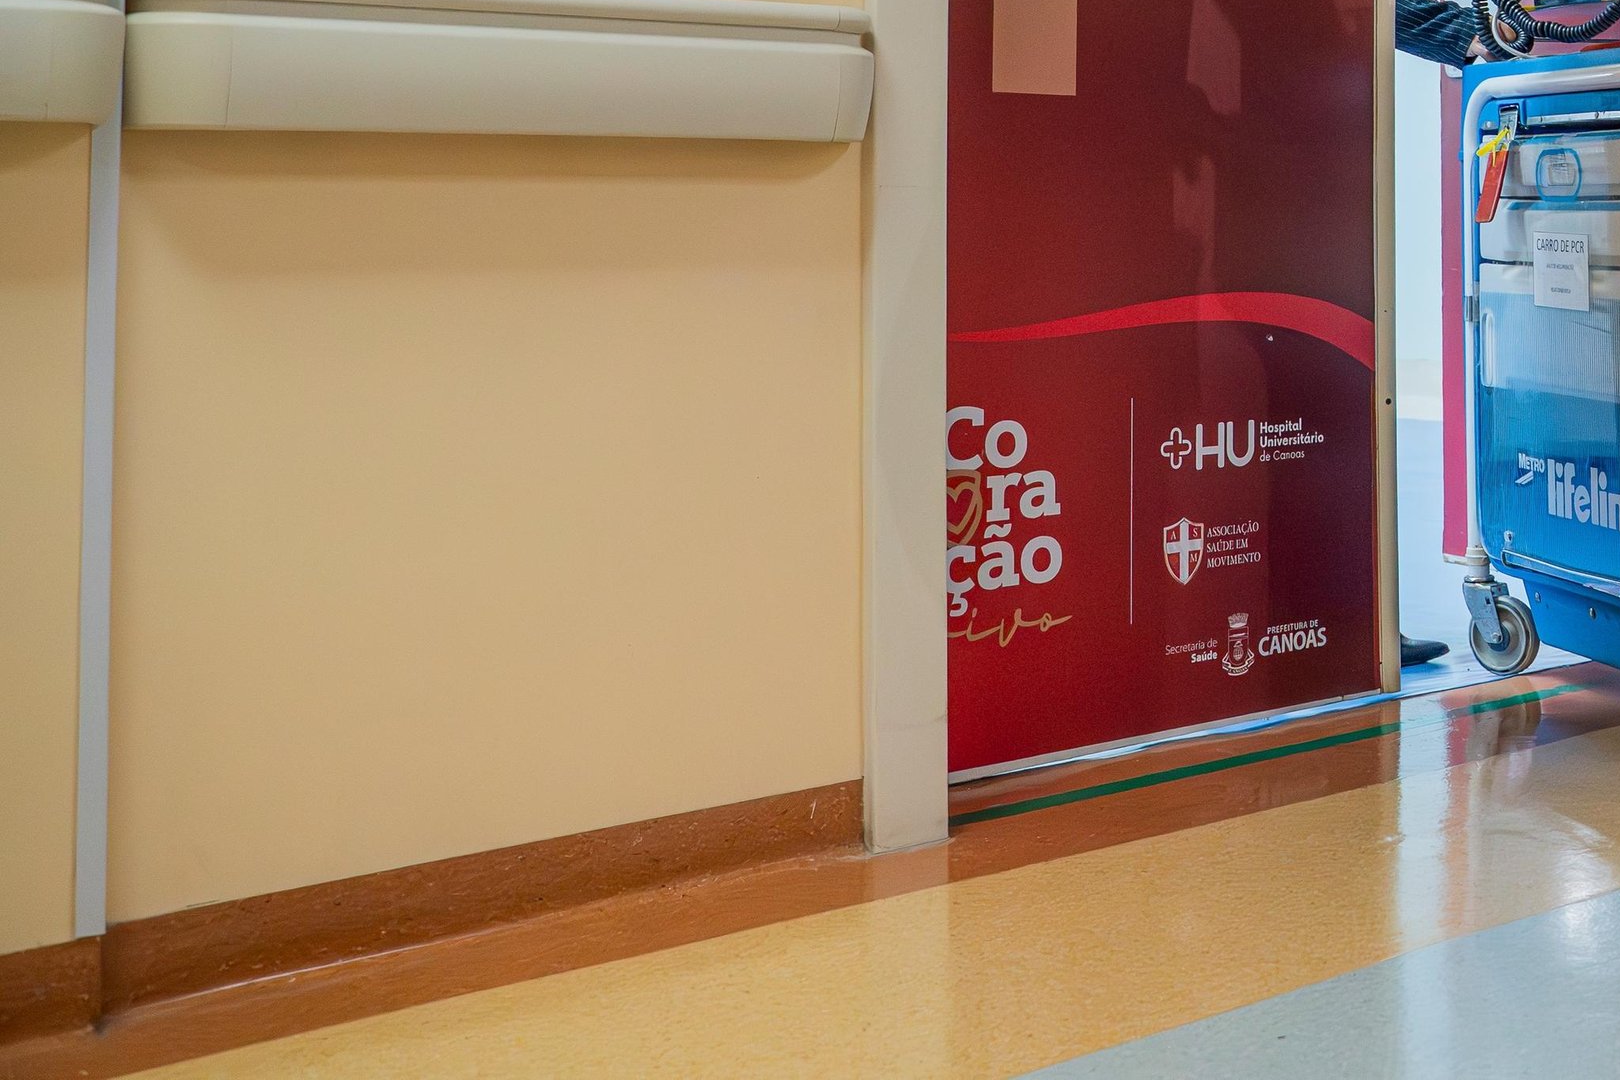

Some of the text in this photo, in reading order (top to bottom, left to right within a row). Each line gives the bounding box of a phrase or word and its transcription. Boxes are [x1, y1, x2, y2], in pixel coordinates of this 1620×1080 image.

[1536, 238, 1585, 253] CARRO DE PCR
[1260, 418, 1302, 437] Hospital
[946, 406, 1028, 470] Co
[1195, 419, 1255, 470] HU
[1259, 432, 1324, 448] Universitário
[1259, 450, 1305, 462] de Canoas
[1519, 453, 1545, 473] METRO
[1207, 519, 1260, 538] ASSOCIAÇÃO
[1207, 538, 1249, 553] SAÚDE EM
[1207, 551, 1261, 569] MOVIMENTO
[1267, 619, 1319, 635] PREFEITURA DE
[1165, 637, 1218, 656] Secretaria de
[1258, 627, 1327, 657] CANOAS
[1191, 650, 1218, 664] Saúde
